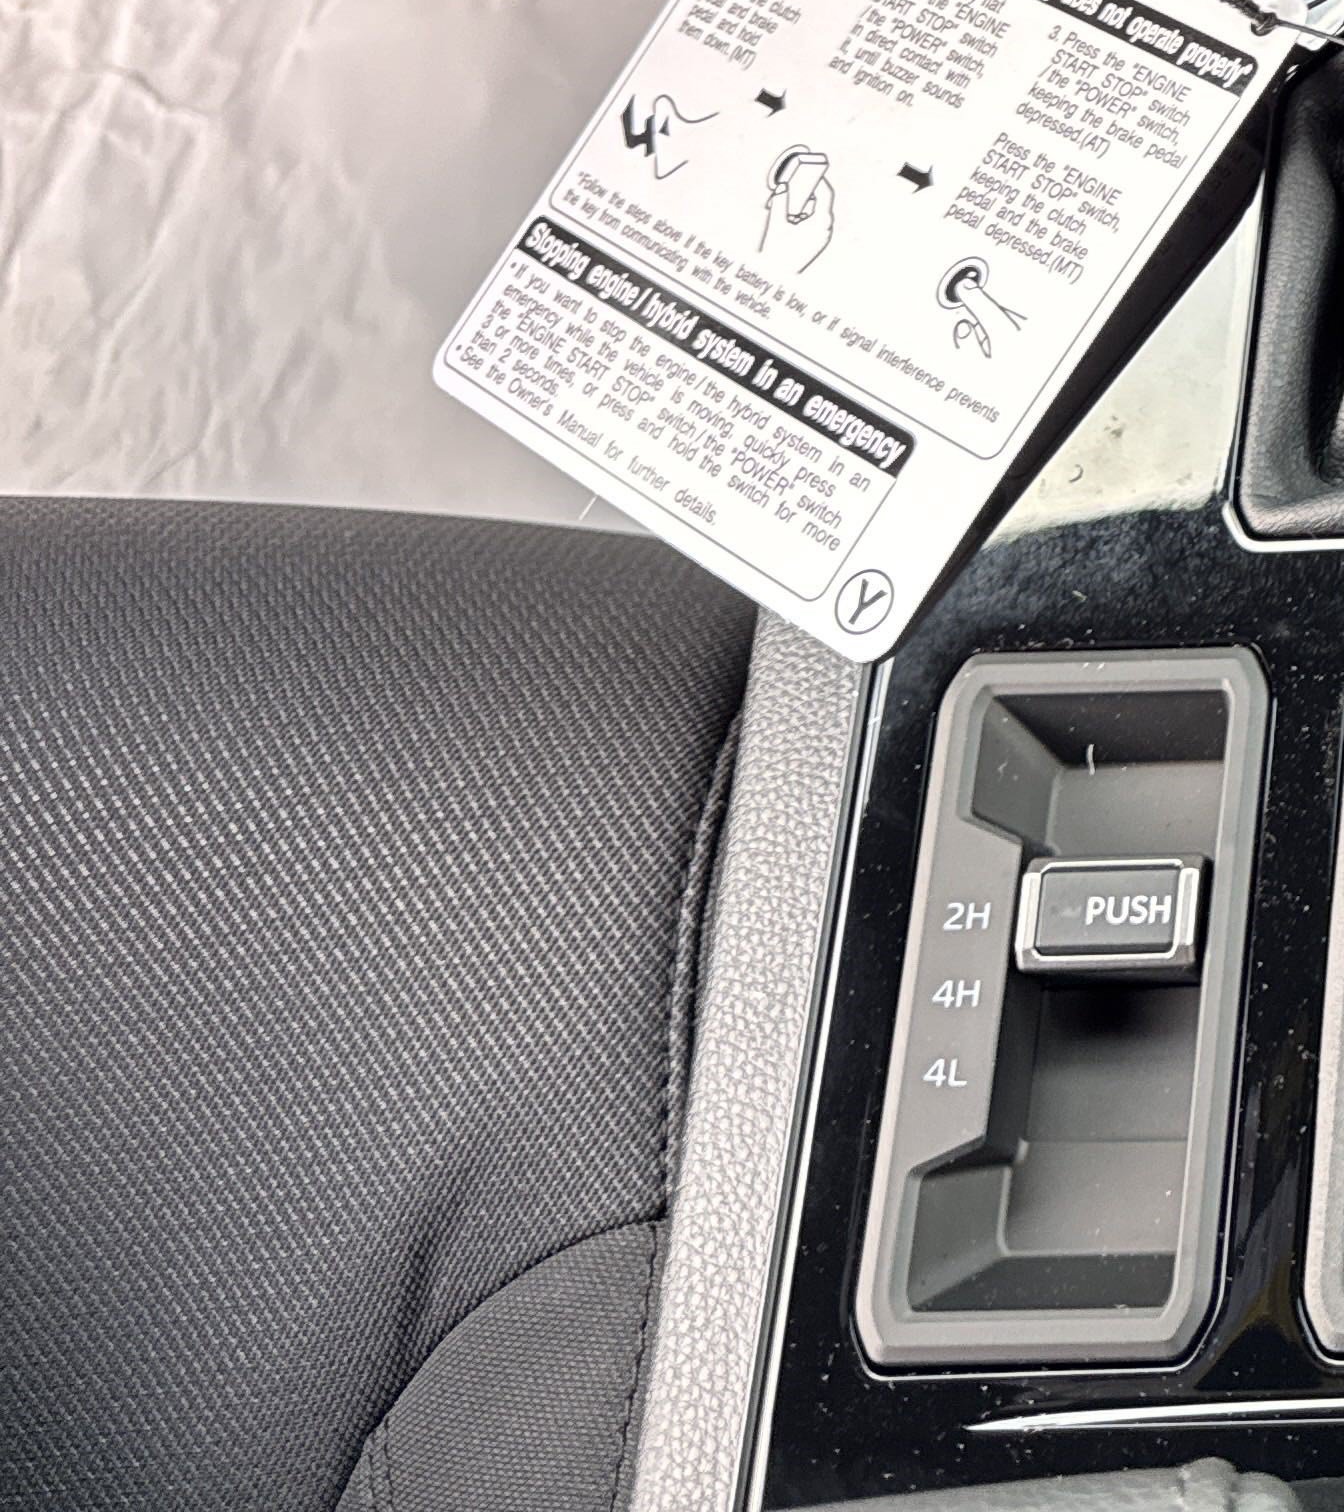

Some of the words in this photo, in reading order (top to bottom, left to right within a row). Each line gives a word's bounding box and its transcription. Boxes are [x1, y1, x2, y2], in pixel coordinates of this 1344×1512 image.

[864, 28, 899, 53] direct
[899, 46, 943, 75] contact
[944, 69, 971, 88] with
[959, 31, 999, 58] switch
[1062, 31, 1102, 59] Press
[1102, 51, 1126, 71] the
[1124, 15, 1185, 56] operate
[852, 66, 895, 96] ignition
[854, 47, 881, 66] until
[880, 57, 921, 86] buzzer
[921, 80, 966, 109] sounds
[1050, 48, 1100, 80] START
[1148, 98, 1191, 127] switch
[1026, 81, 1080, 120] keeping
[1079, 108, 1104, 129] the
[1105, 119, 1145, 149] brake
[1143, 142, 1187, 170] pedal
[982, 148, 1030, 181] START
[993, 132, 1032, 161] Press
[1032, 152, 1057, 174] the
[943, 202, 985, 230] pedal
[955, 185, 997, 212] pedal
[995, 205, 1026, 227] and
[1024, 217, 1049, 239] the
[1049, 230, 1089, 260] brake
[968, 166, 1021, 205] keeping
[1020, 193, 1045, 216] the
[1045, 207, 1088, 237] clutch
[470, 330, 498, 355] than
[520, 221, 592, 281] Stopping
[691, 327, 756, 378] system
[801, 394, 906, 474] emergency
[524, 273, 550, 295] you
[552, 289, 583, 314] want
[599, 319, 627, 344] stop
[628, 335, 651, 357] the
[726, 394, 771, 431] hybrid
[772, 425, 823, 464] system
[490, 299, 512, 321] the
[566, 346, 611, 381] START
[796, 493, 843, 529] switch
[502, 284, 563, 330] emergency
[564, 321, 596, 348] while
[597, 341, 619, 363] the
[622, 358, 669, 392] vehicle
[742, 433, 792, 471] quickly
[793, 466, 836, 498] press
[507, 377, 554, 417] Owner's
[556, 409, 604, 448] Manual
[627, 455, 671, 492] further
[508, 335, 540, 361] more
[598, 393, 635, 422] press
[637, 416, 666, 440] and
[667, 433, 700, 462] hold
[698, 454, 723, 478] the
[727, 473, 771, 508] switch
[801, 521, 841, 551] more
[848, 579, 886, 624] Y
[943, 902, 991, 931] 2H
[1085, 895, 1172, 926] PUSH
[932, 980, 980, 1008] 4H
[923, 1059, 967, 1087] 4L
